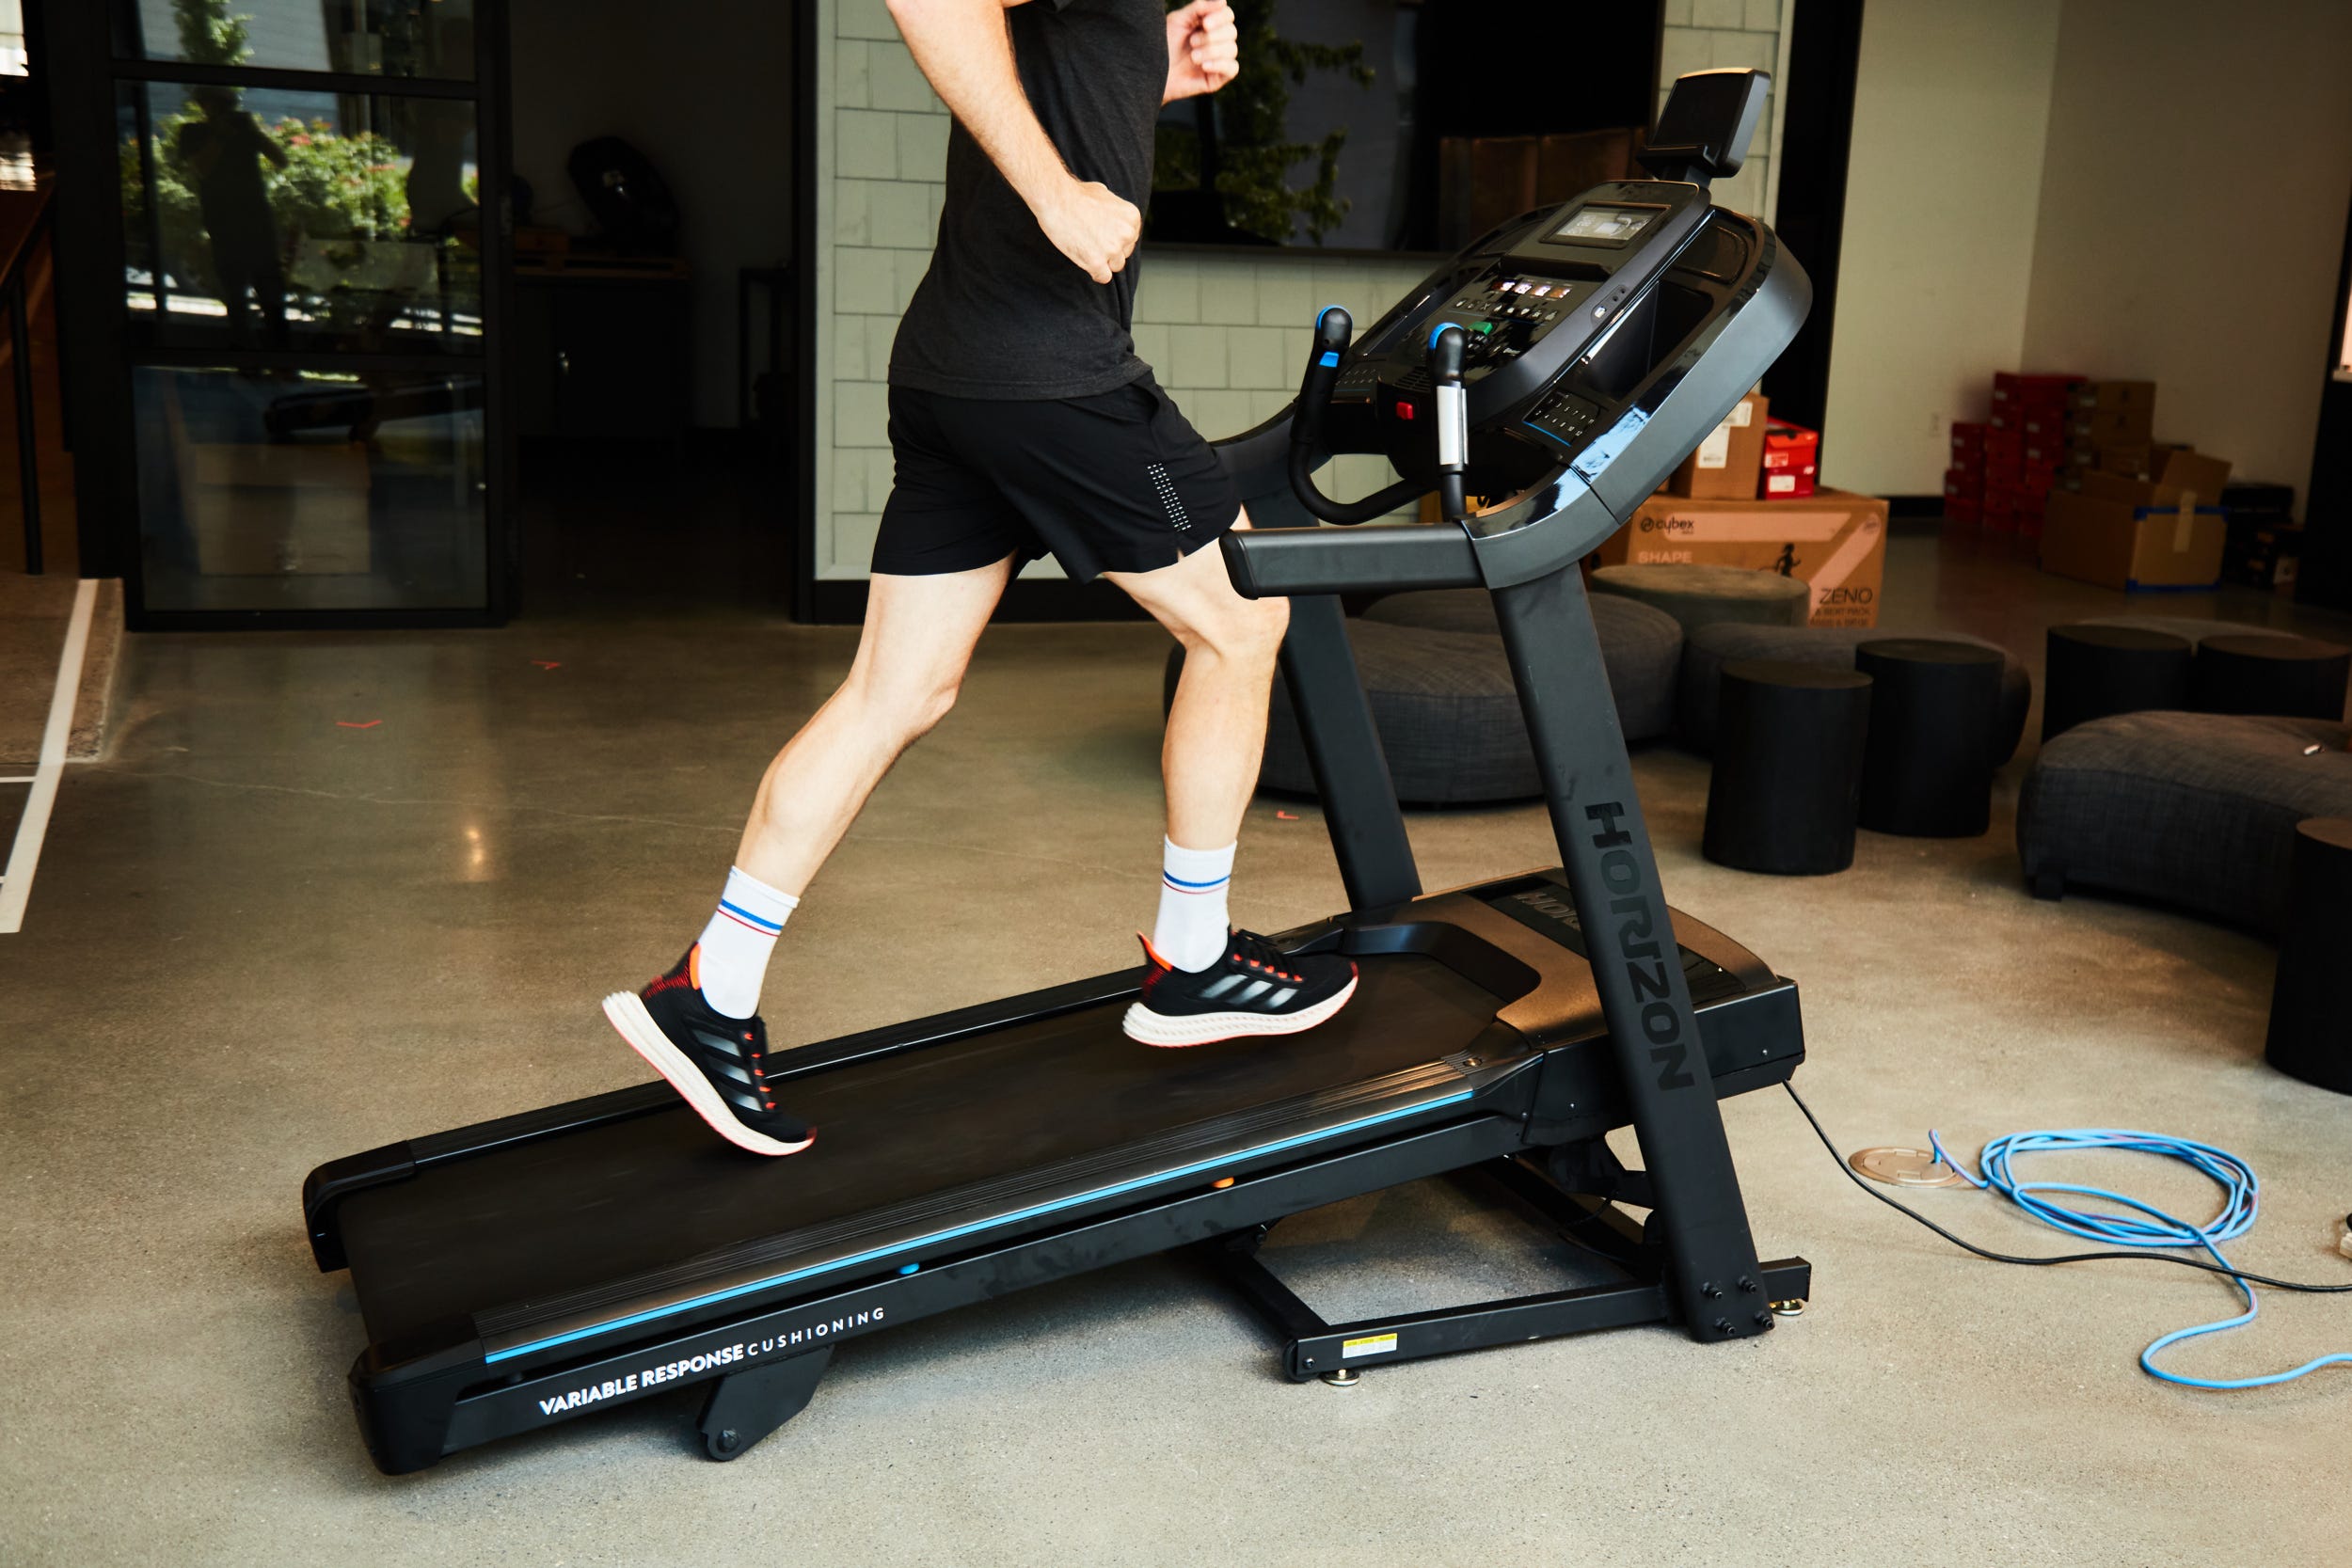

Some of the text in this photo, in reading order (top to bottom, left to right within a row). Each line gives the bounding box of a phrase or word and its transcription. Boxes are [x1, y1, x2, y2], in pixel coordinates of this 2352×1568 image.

[1656, 516, 1693, 534] cybex
[1638, 551, 1692, 563] SHAPE
[1820, 587, 1873, 605] ZENO
[539, 1307, 884, 1416] VARIABLE RESPONSE CUSHIONING
